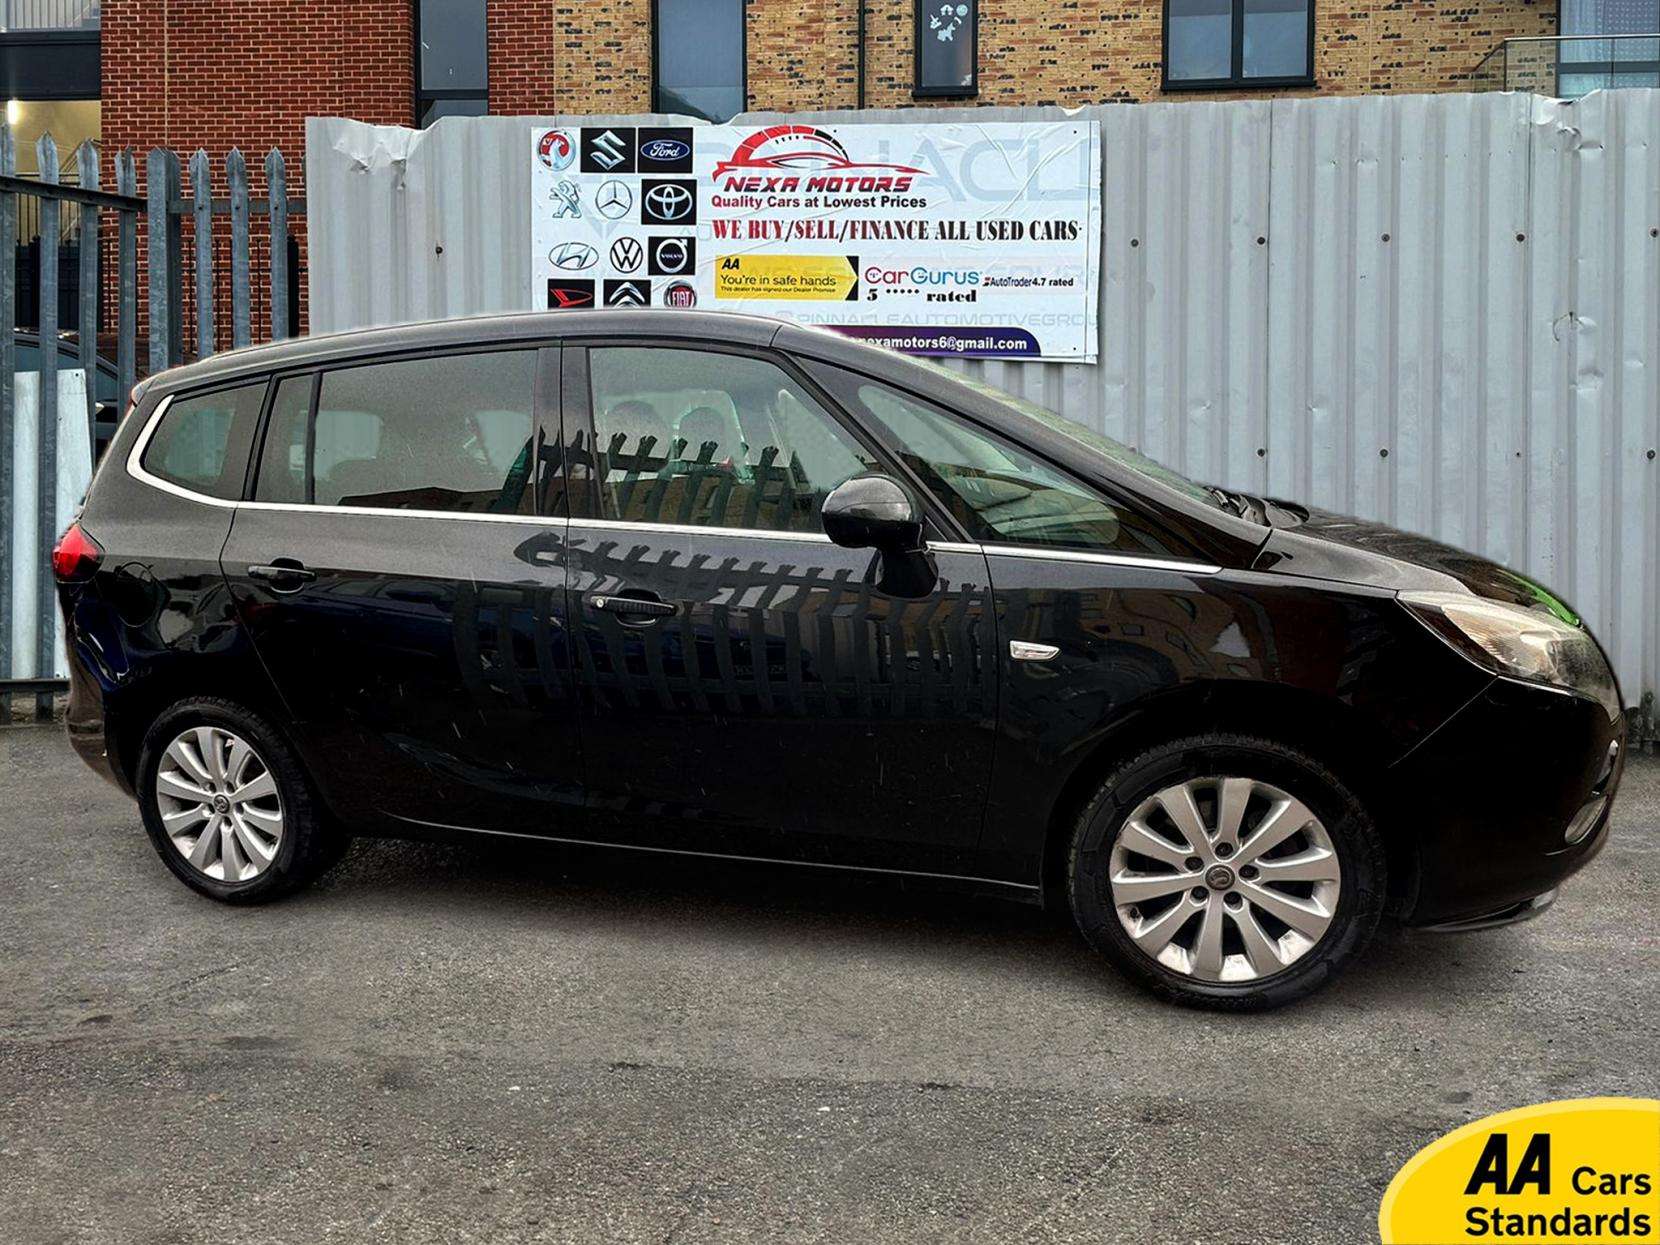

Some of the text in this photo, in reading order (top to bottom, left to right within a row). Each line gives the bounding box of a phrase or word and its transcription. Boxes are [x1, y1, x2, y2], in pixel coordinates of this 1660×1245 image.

[649, 143, 679, 157] Ford
[723, 176, 913, 193] NEXA MOTORS
[711, 195, 927, 210] Quality Cars at Lowest Prices
[712, 219, 742, 240] WE
[934, 220, 970, 240] ALL
[976, 220, 1024, 241] USED
[1029, 220, 1079, 241] CARS
[721, 257, 740, 270] AA
[720, 274, 836, 287] You're in safe hands
[864, 266, 981, 286] CarGurus
[990, 277, 1074, 287] AutoTrader 4.7 rated
[672, 291, 690, 307] FIAT
[867, 289, 977, 302] 5 rated
